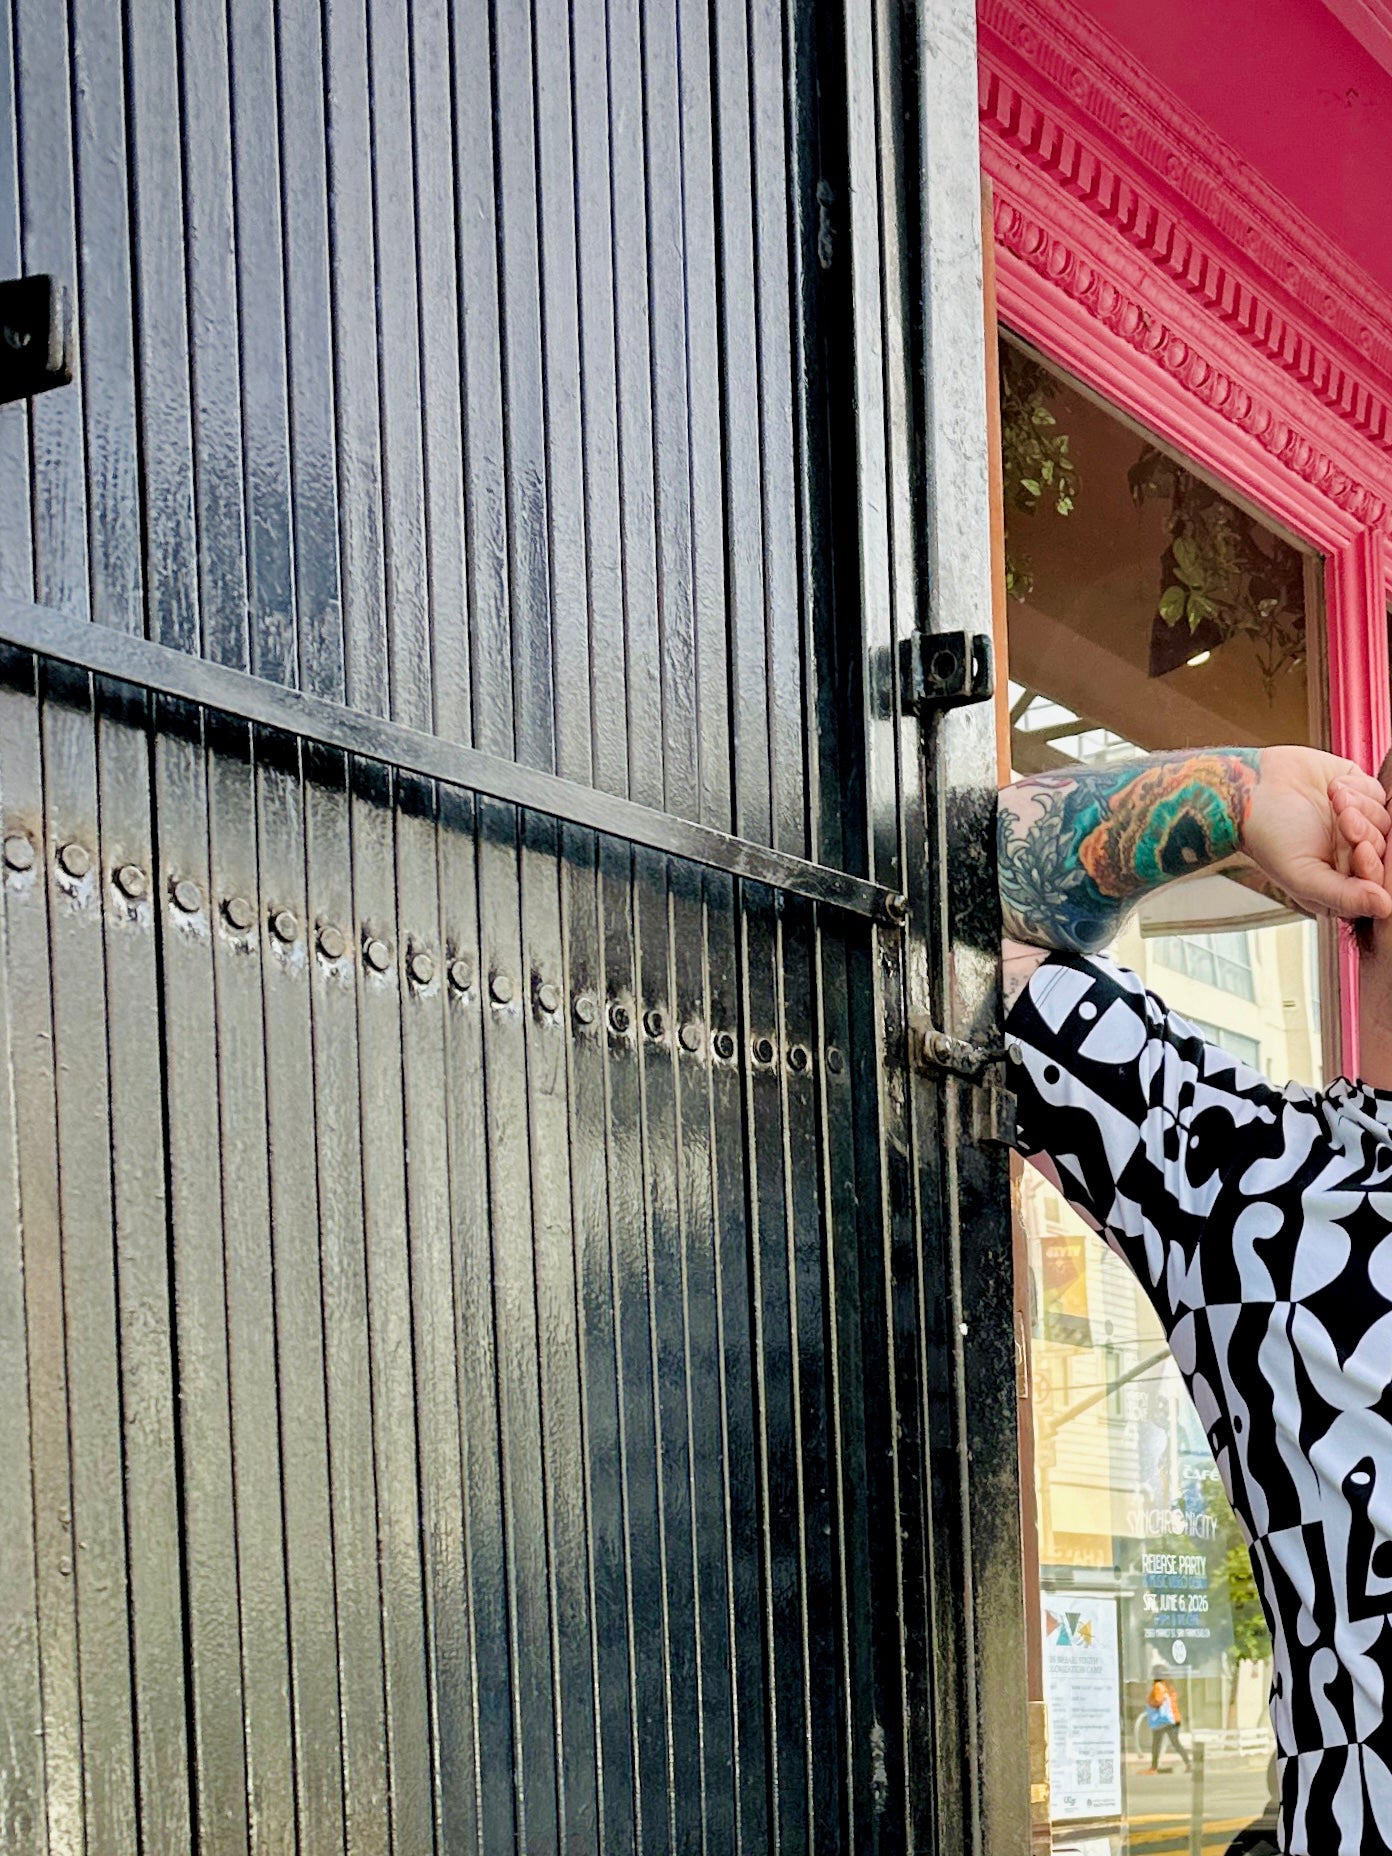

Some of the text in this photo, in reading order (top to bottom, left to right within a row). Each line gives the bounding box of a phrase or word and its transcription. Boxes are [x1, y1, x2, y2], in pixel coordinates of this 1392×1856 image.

[1142, 1553, 1206, 1577] RELEASE PARTY
[1188, 1595, 1209, 1612] 2026
